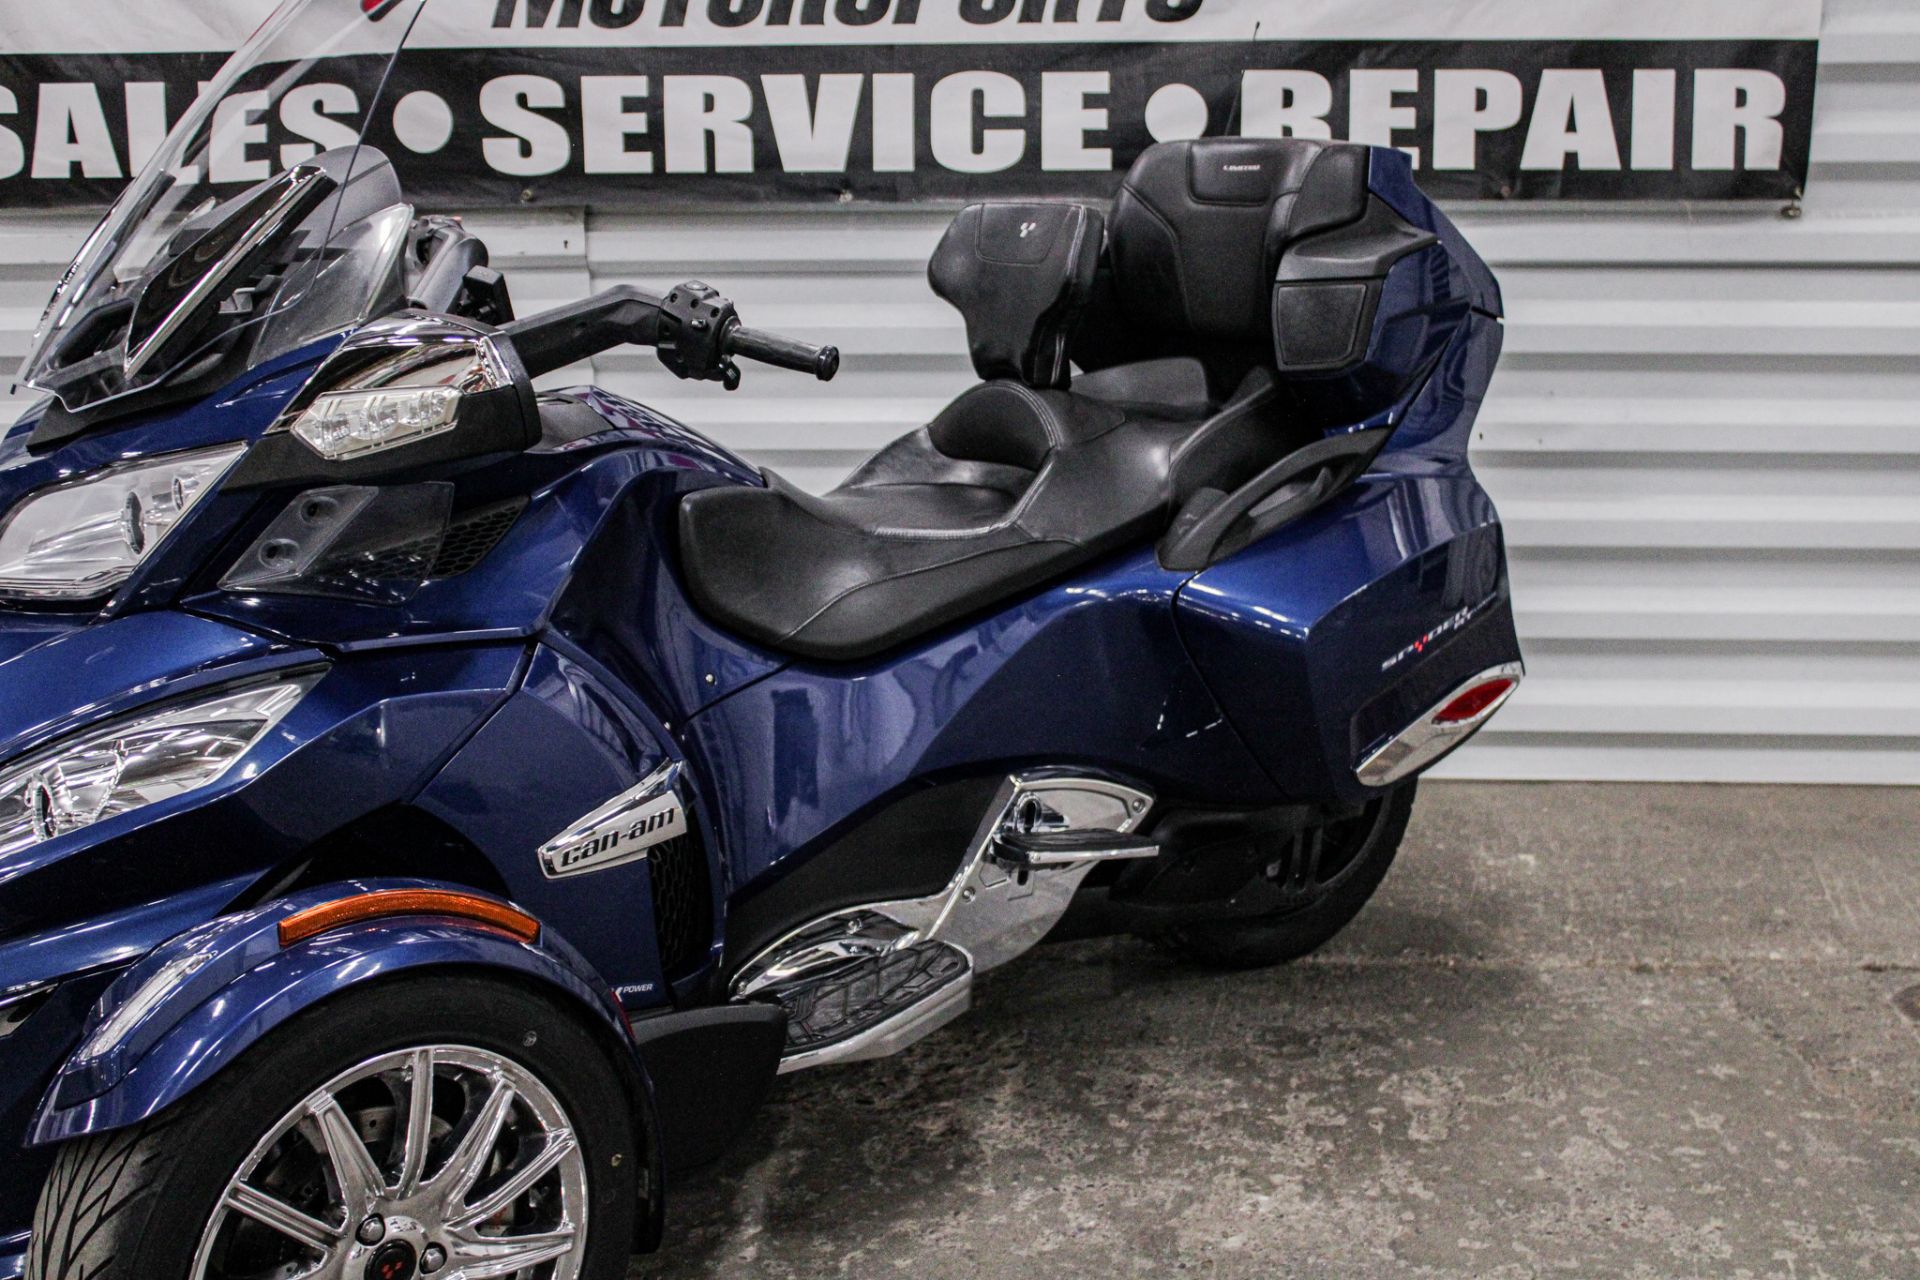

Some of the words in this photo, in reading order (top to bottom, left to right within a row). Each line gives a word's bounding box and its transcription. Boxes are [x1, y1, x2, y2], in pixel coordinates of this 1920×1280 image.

[480, 70, 1112, 175] SERVICE
[1240, 68, 1786, 171] REPAIR
[561, 807, 675, 868] can-am
[623, 983, 653, 993] POWER
